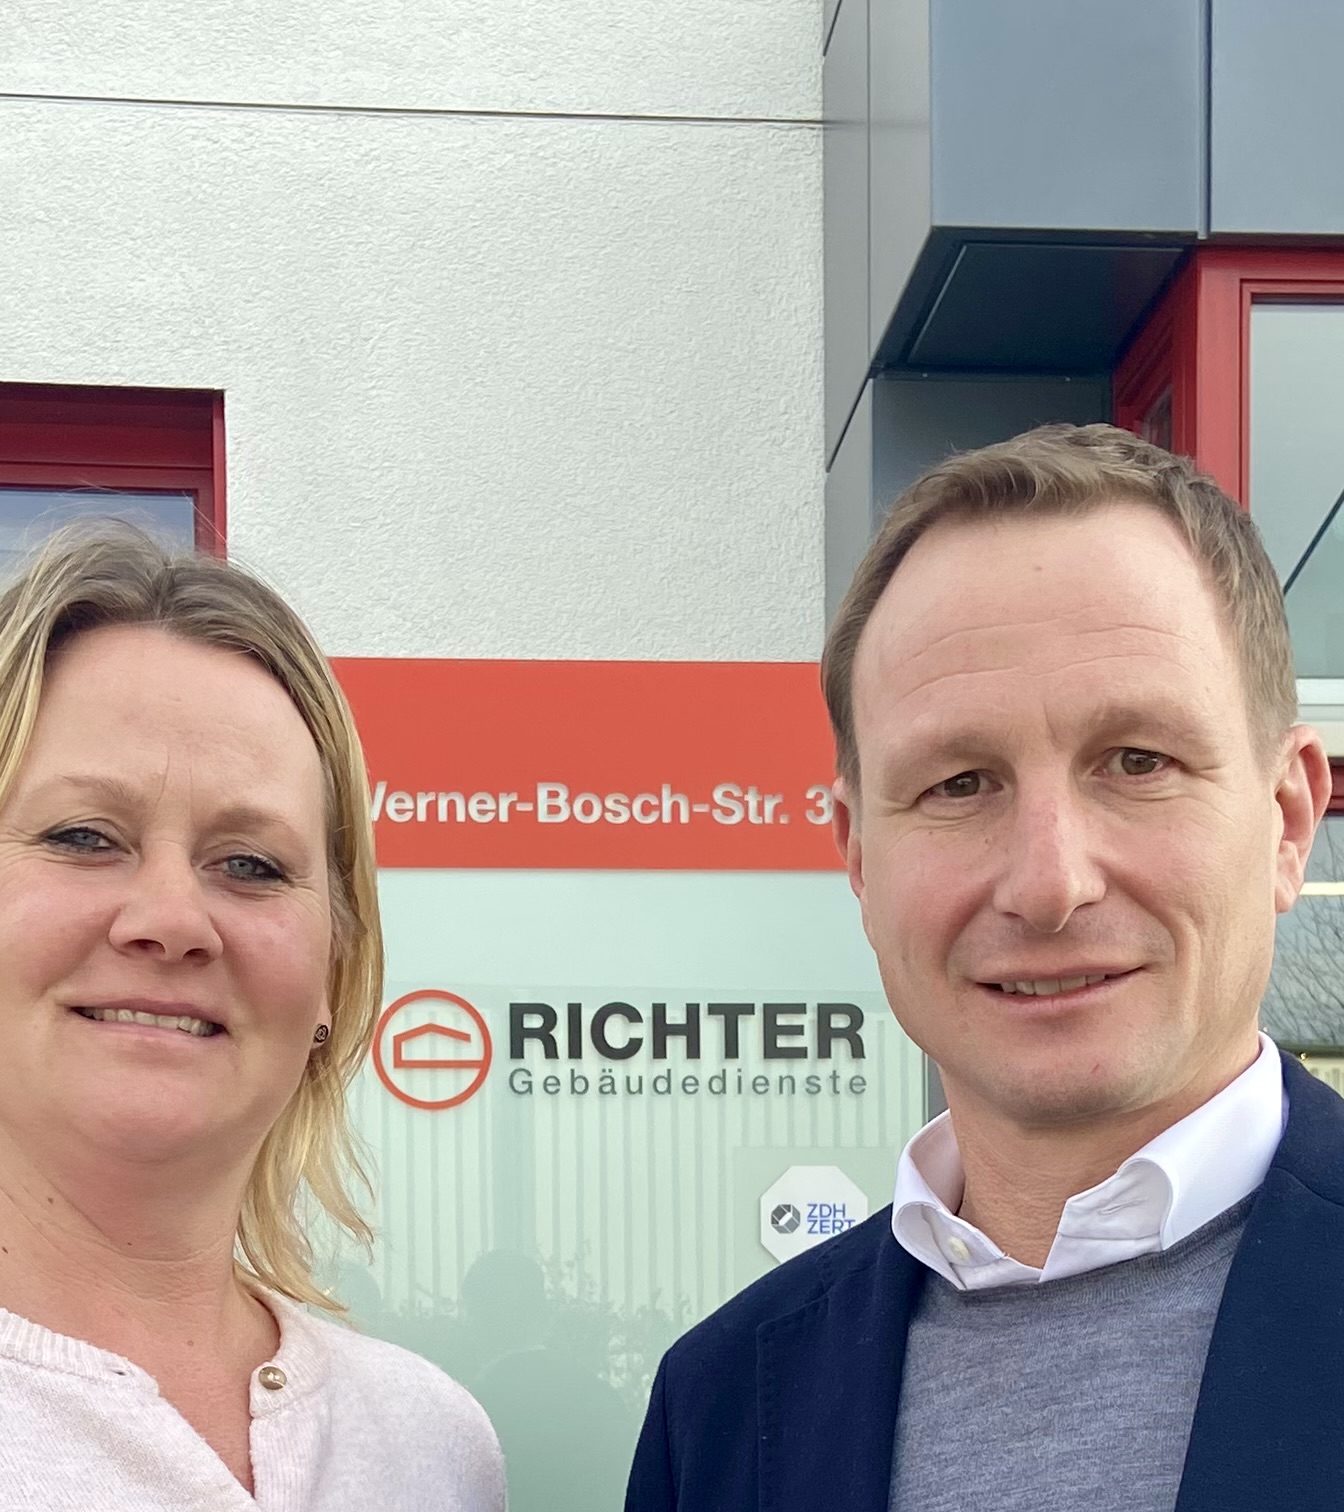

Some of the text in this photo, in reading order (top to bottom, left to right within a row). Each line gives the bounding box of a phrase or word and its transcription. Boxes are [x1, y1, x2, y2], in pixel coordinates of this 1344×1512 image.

[805, 784, 833, 825] 3
[508, 1001, 866, 1061] RICHTER
[508, 1067, 868, 1096] Gebäudedienste
[807, 1203, 846, 1219] ZDH
